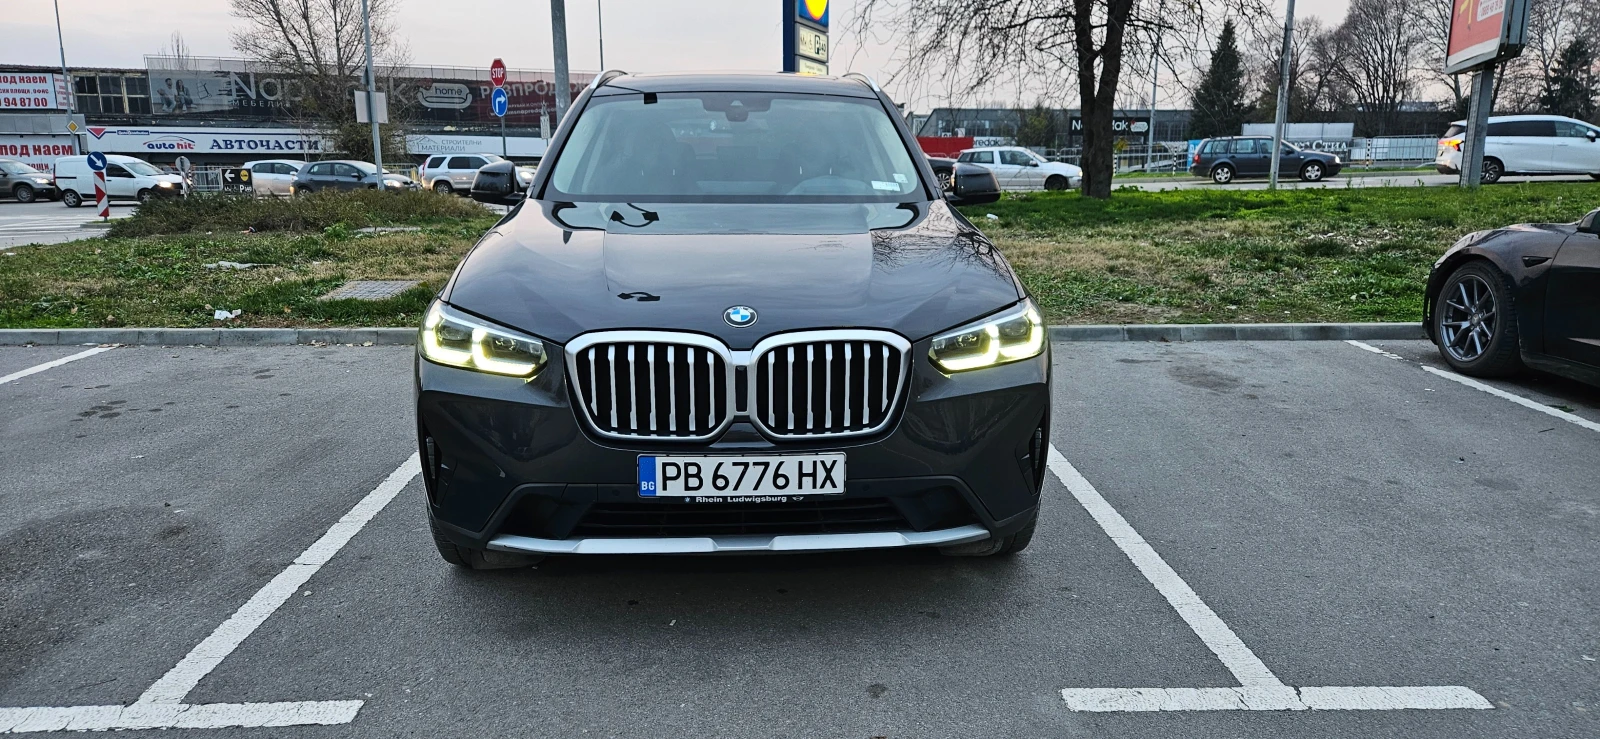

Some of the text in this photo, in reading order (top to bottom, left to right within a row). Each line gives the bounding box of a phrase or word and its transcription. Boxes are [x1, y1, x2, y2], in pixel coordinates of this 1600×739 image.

[492, 68, 504, 78] STOP
[0, 76, 17, 84] од
[434, 86, 462, 95] home
[4, 97, 17, 107] 94
[20, 97, 31, 107] 87
[34, 97, 47, 107] 00
[147, 141, 194, 150] auto hit
[210, 139, 319, 150] АВТОЧАСТИ
[0, 144, 73, 157] под наем
[712, 461, 790, 491] 6776
[641, 481, 655, 490] BG
[727, 496, 787, 504] Ludwigsburg
